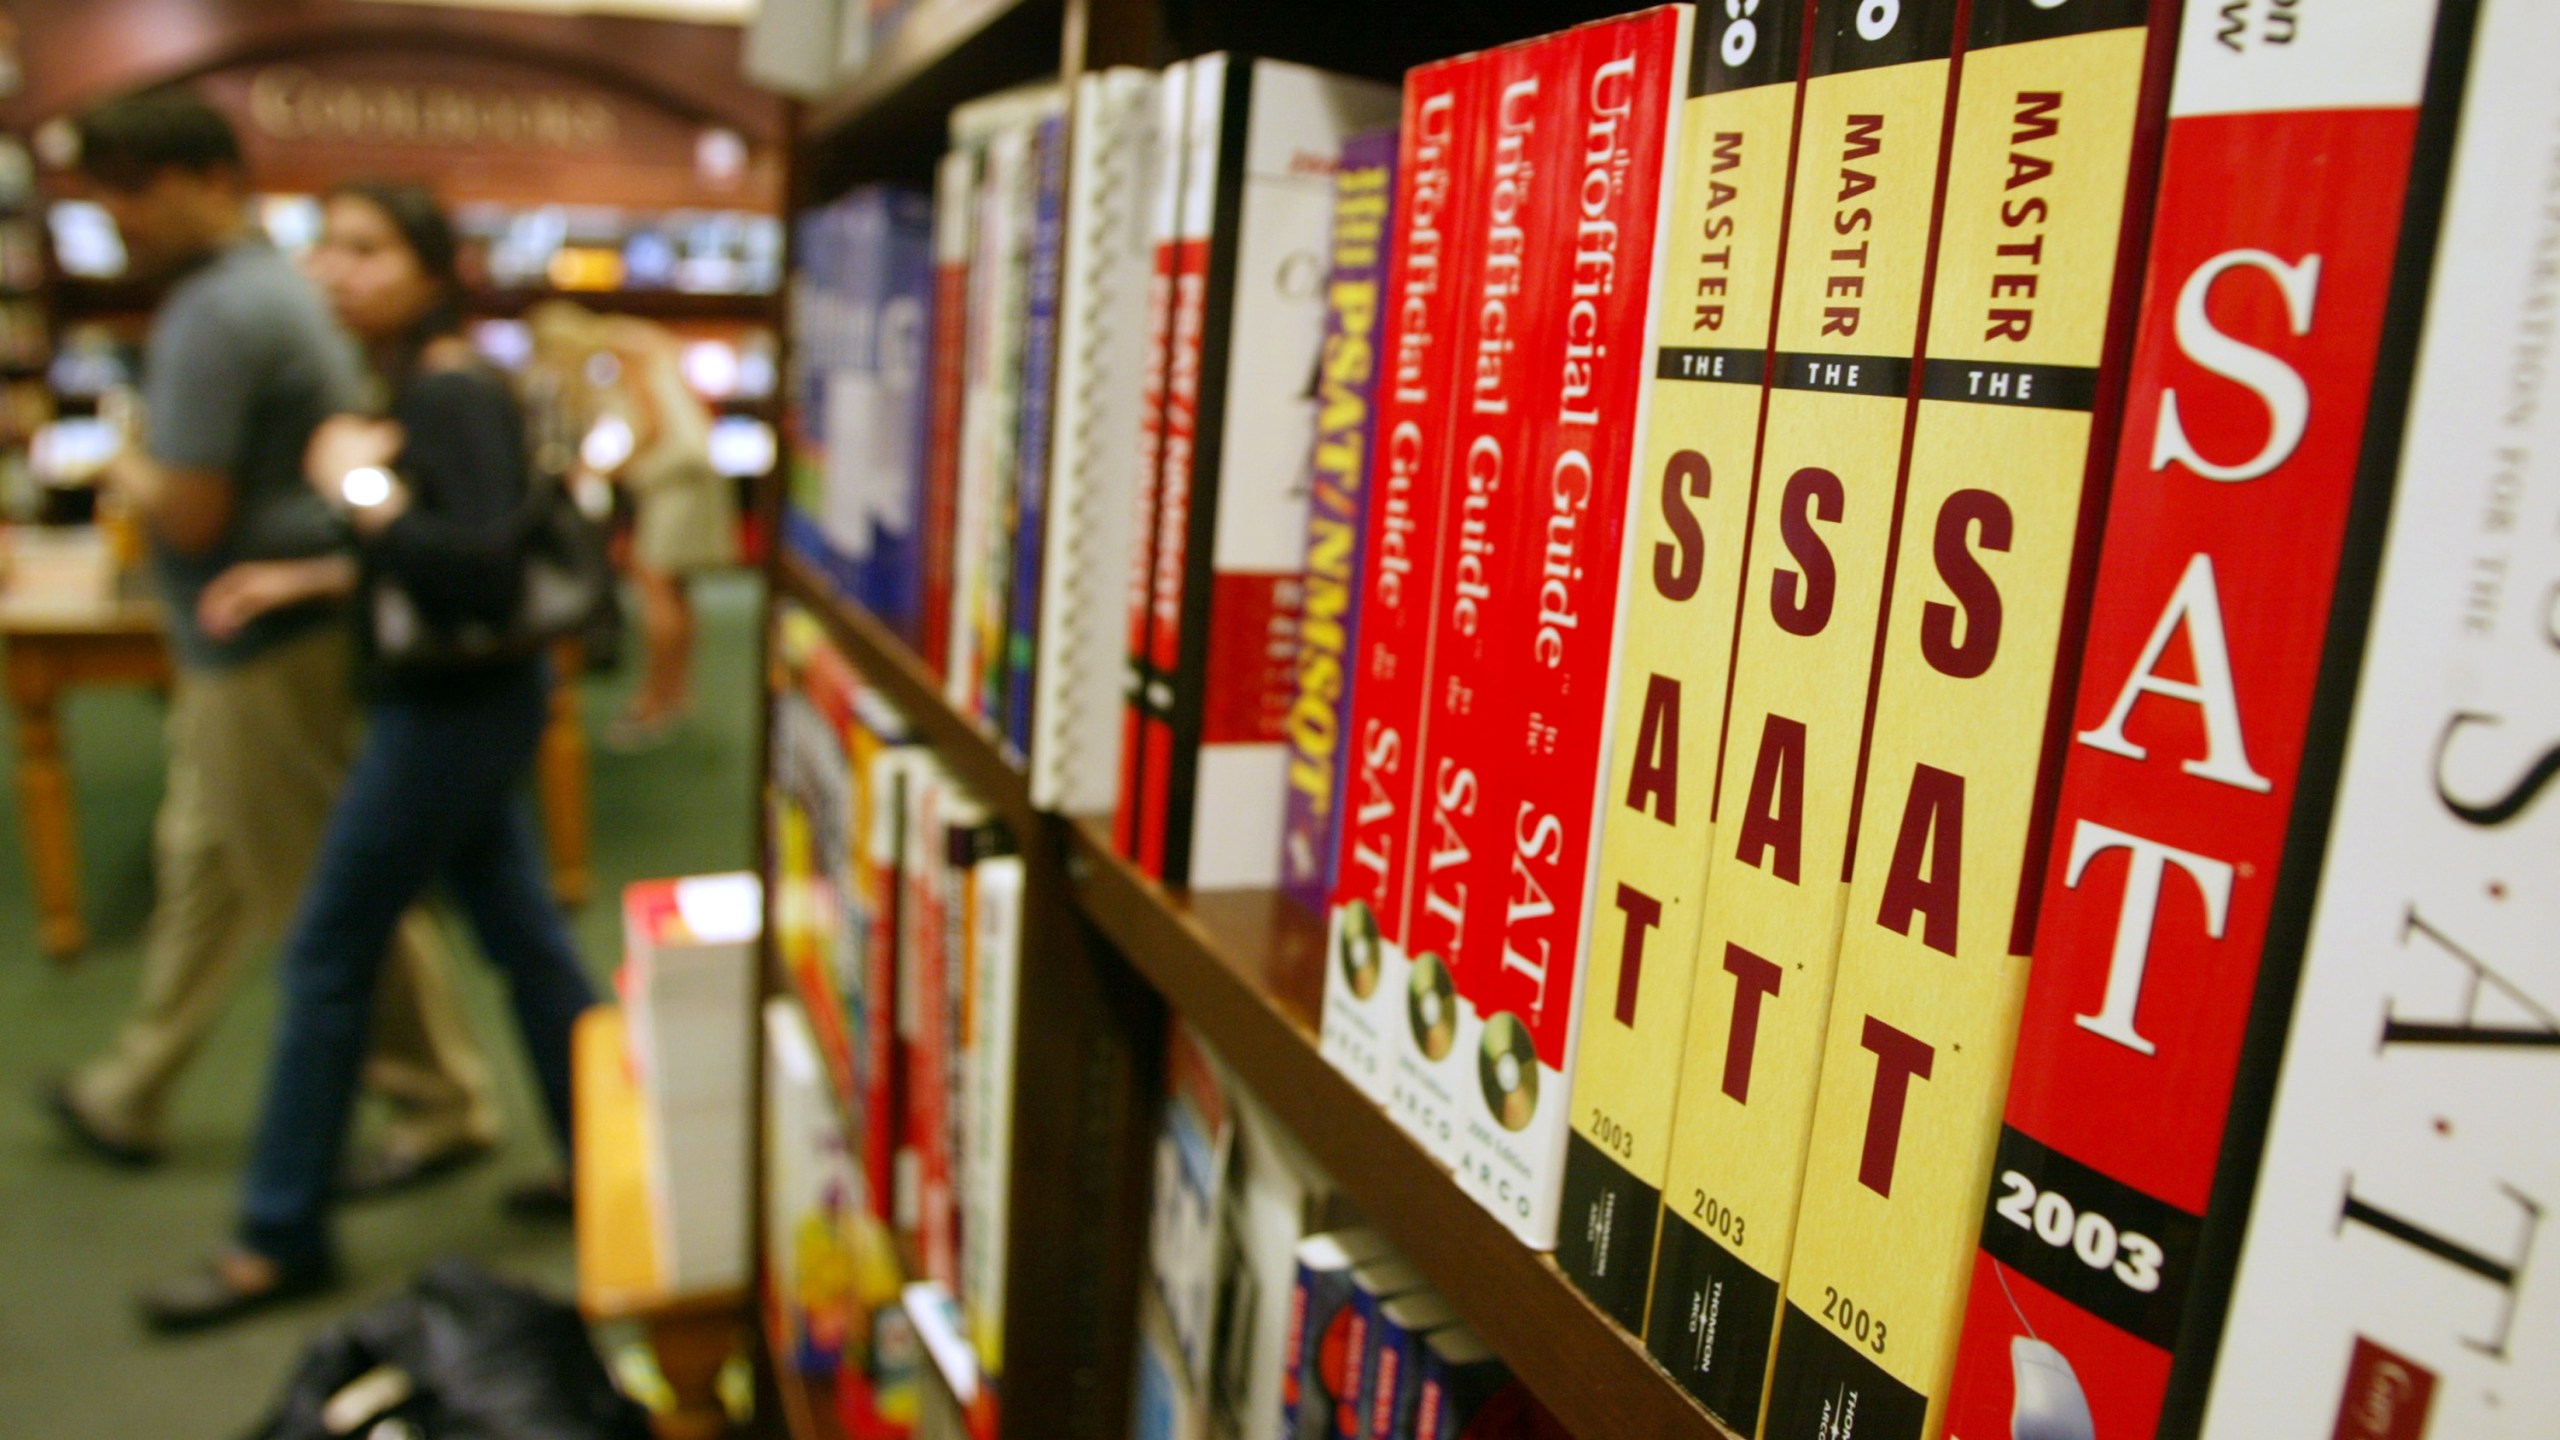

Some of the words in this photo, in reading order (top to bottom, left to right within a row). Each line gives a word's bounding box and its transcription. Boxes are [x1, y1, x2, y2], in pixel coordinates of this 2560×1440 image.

[1396, 92, 1454, 403] Unofficial
[1473, 78, 1539, 414] Unofficial
[1559, 50, 1637, 427] Unofficial
[1693, 132, 1743, 333] MASTER
[1822, 114, 1884, 337] MASTER
[1985, 90, 2063, 342] MASTER
[1681, 354, 1724, 378] THE
[1807, 361, 1861, 388] THE
[1967, 370, 2033, 400] THE
[1288, 280, 1379, 816] PSAT/NMSQT
[1378, 421, 1424, 607] Guide
[1453, 436, 1502, 637] Guide
[1535, 449, 1593, 669] Guide
[1614, 449, 1712, 1029] SAT
[2067, 249, 2319, 1054] SAT
[1353, 718, 1400, 904] SAT
[1425, 756, 1478, 955] SAT
[1721, 467, 1845, 1106] SAT
[1857, 488, 2013, 1200] SAT
[1501, 800, 1563, 1013] SAT
[1461, 1152, 1530, 1219] ARCO
[1591, 1108, 1633, 1160] 2003
[1692, 1188, 1746, 1247] 2003
[1996, 1170, 2165, 1293] 2003
[1689, 1291, 1701, 1334] ARCO
[1702, 1281, 1723, 1373] THOMSON
[1821, 1285, 1888, 1355] 2003
